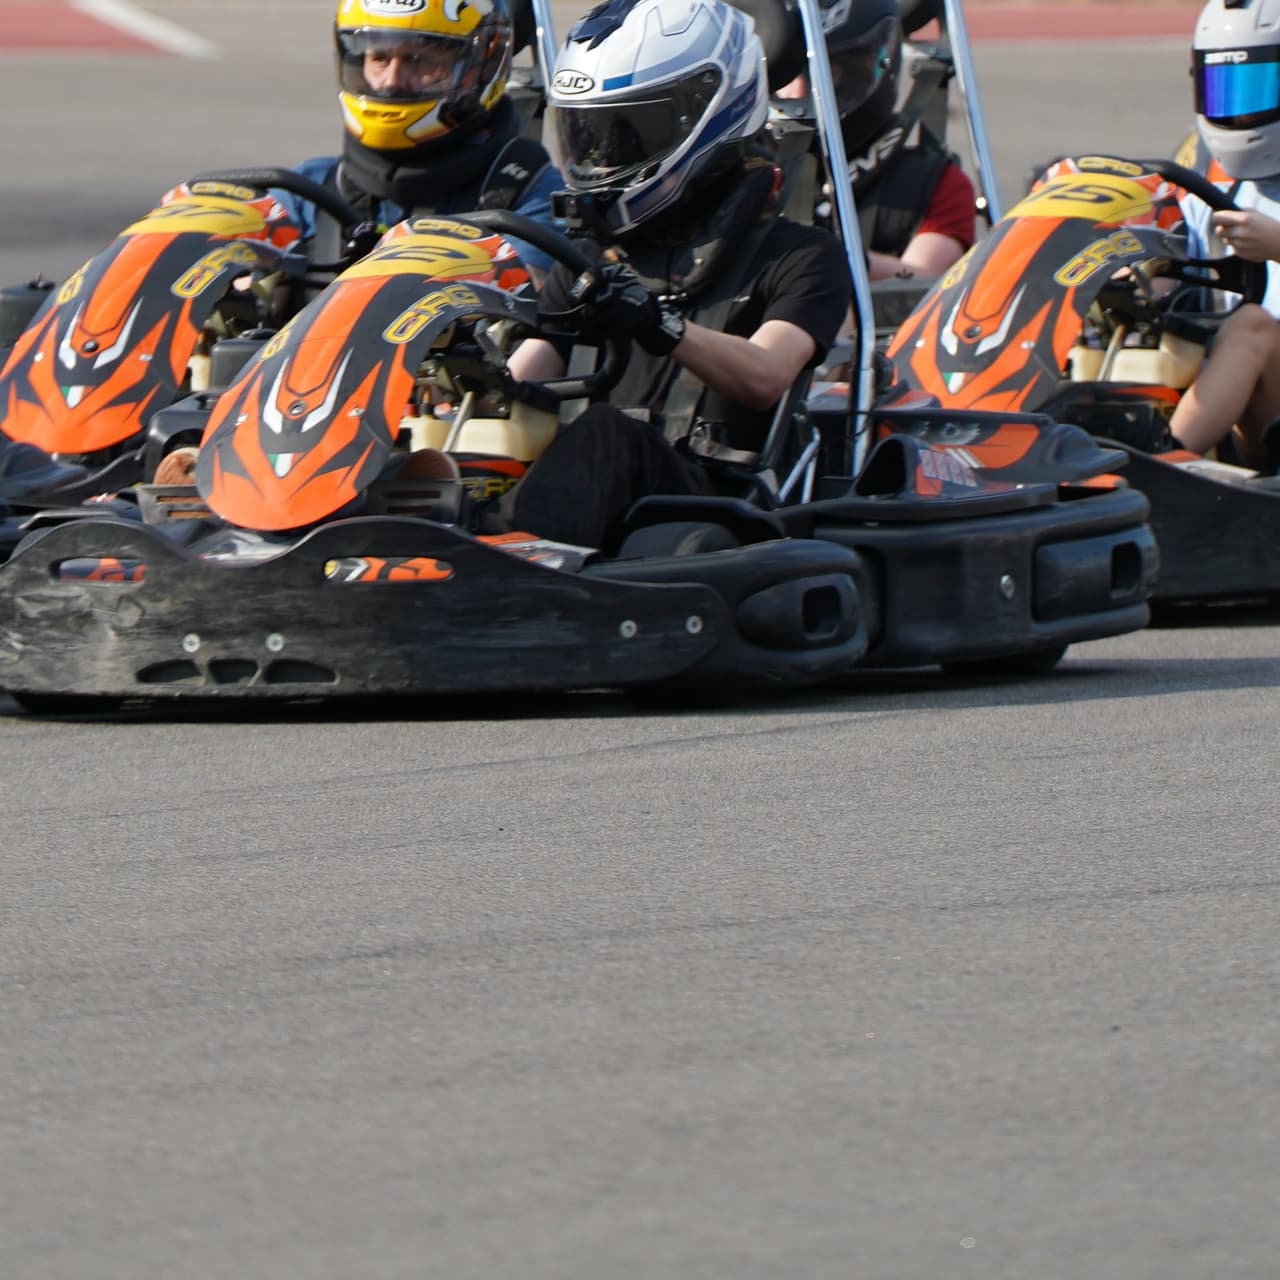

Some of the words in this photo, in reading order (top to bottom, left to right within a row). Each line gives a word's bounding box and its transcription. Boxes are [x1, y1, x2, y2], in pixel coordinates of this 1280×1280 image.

[1078, 156, 1143, 176] CRG
[1024, 183, 1136, 205] 15
[412, 219, 483, 239] CRG
[382, 283, 483, 345] CRG
